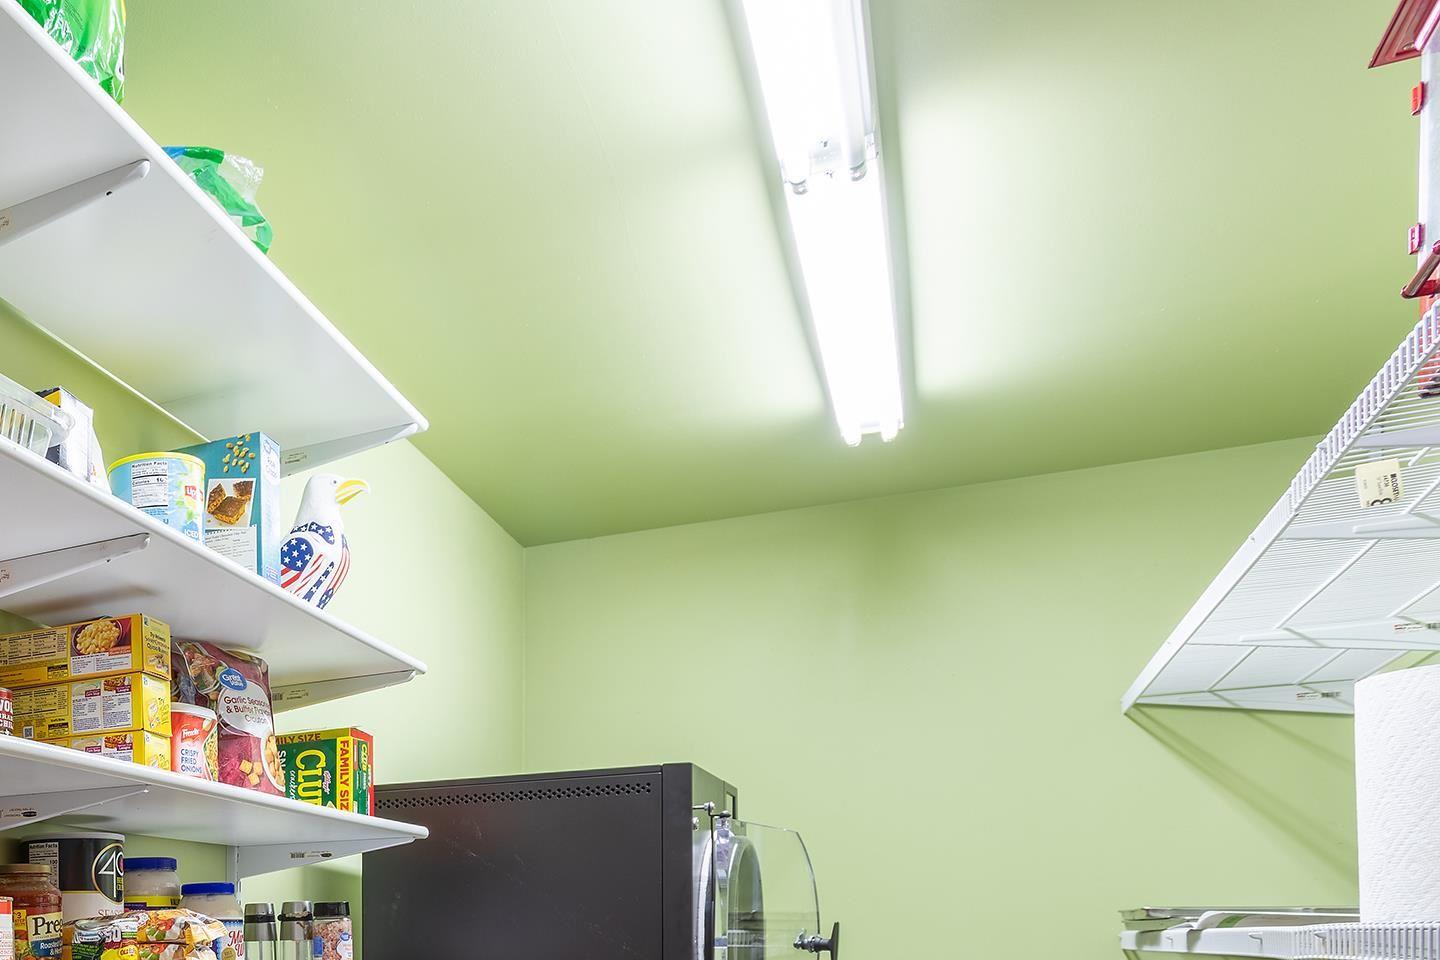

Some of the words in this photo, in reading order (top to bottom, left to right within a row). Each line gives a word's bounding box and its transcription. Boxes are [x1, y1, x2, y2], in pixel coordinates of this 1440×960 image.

[224, 695, 247, 705] Garlic
[226, 705, 233, 714] &
[275, 735, 296, 745] MILY
[298, 733, 321, 743] SIZE
[180, 748, 199, 757] CRISPY
[180, 756, 197, 765] FRIED
[340, 740, 350, 786] FAMILY
[180, 764, 203, 774] ONIONS
[340, 789, 350, 812] SIZ
[32, 916, 62, 937] Pre
